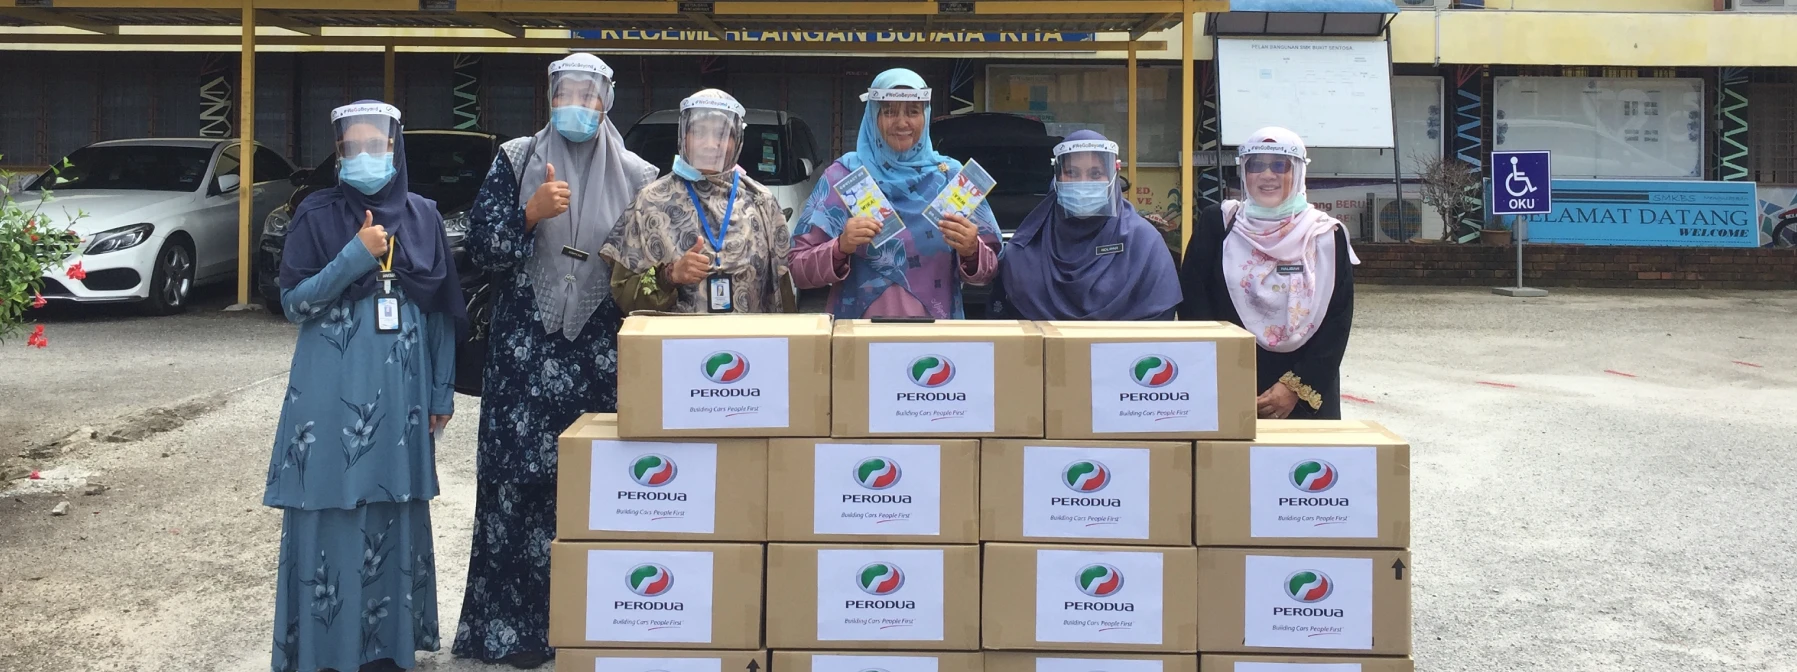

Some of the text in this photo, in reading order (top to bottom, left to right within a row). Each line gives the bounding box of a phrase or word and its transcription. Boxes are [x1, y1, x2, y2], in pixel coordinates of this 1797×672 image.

[1653, 194, 1697, 202] SMKBS
[1509, 199, 1535, 209] OKU
[1638, 208, 1749, 227] DATANG
[1679, 228, 1750, 238] WELCOME
[616, 508, 639, 516] Building
[1064, 619, 1086, 627] Building
[1310, 625, 1329, 633] People
